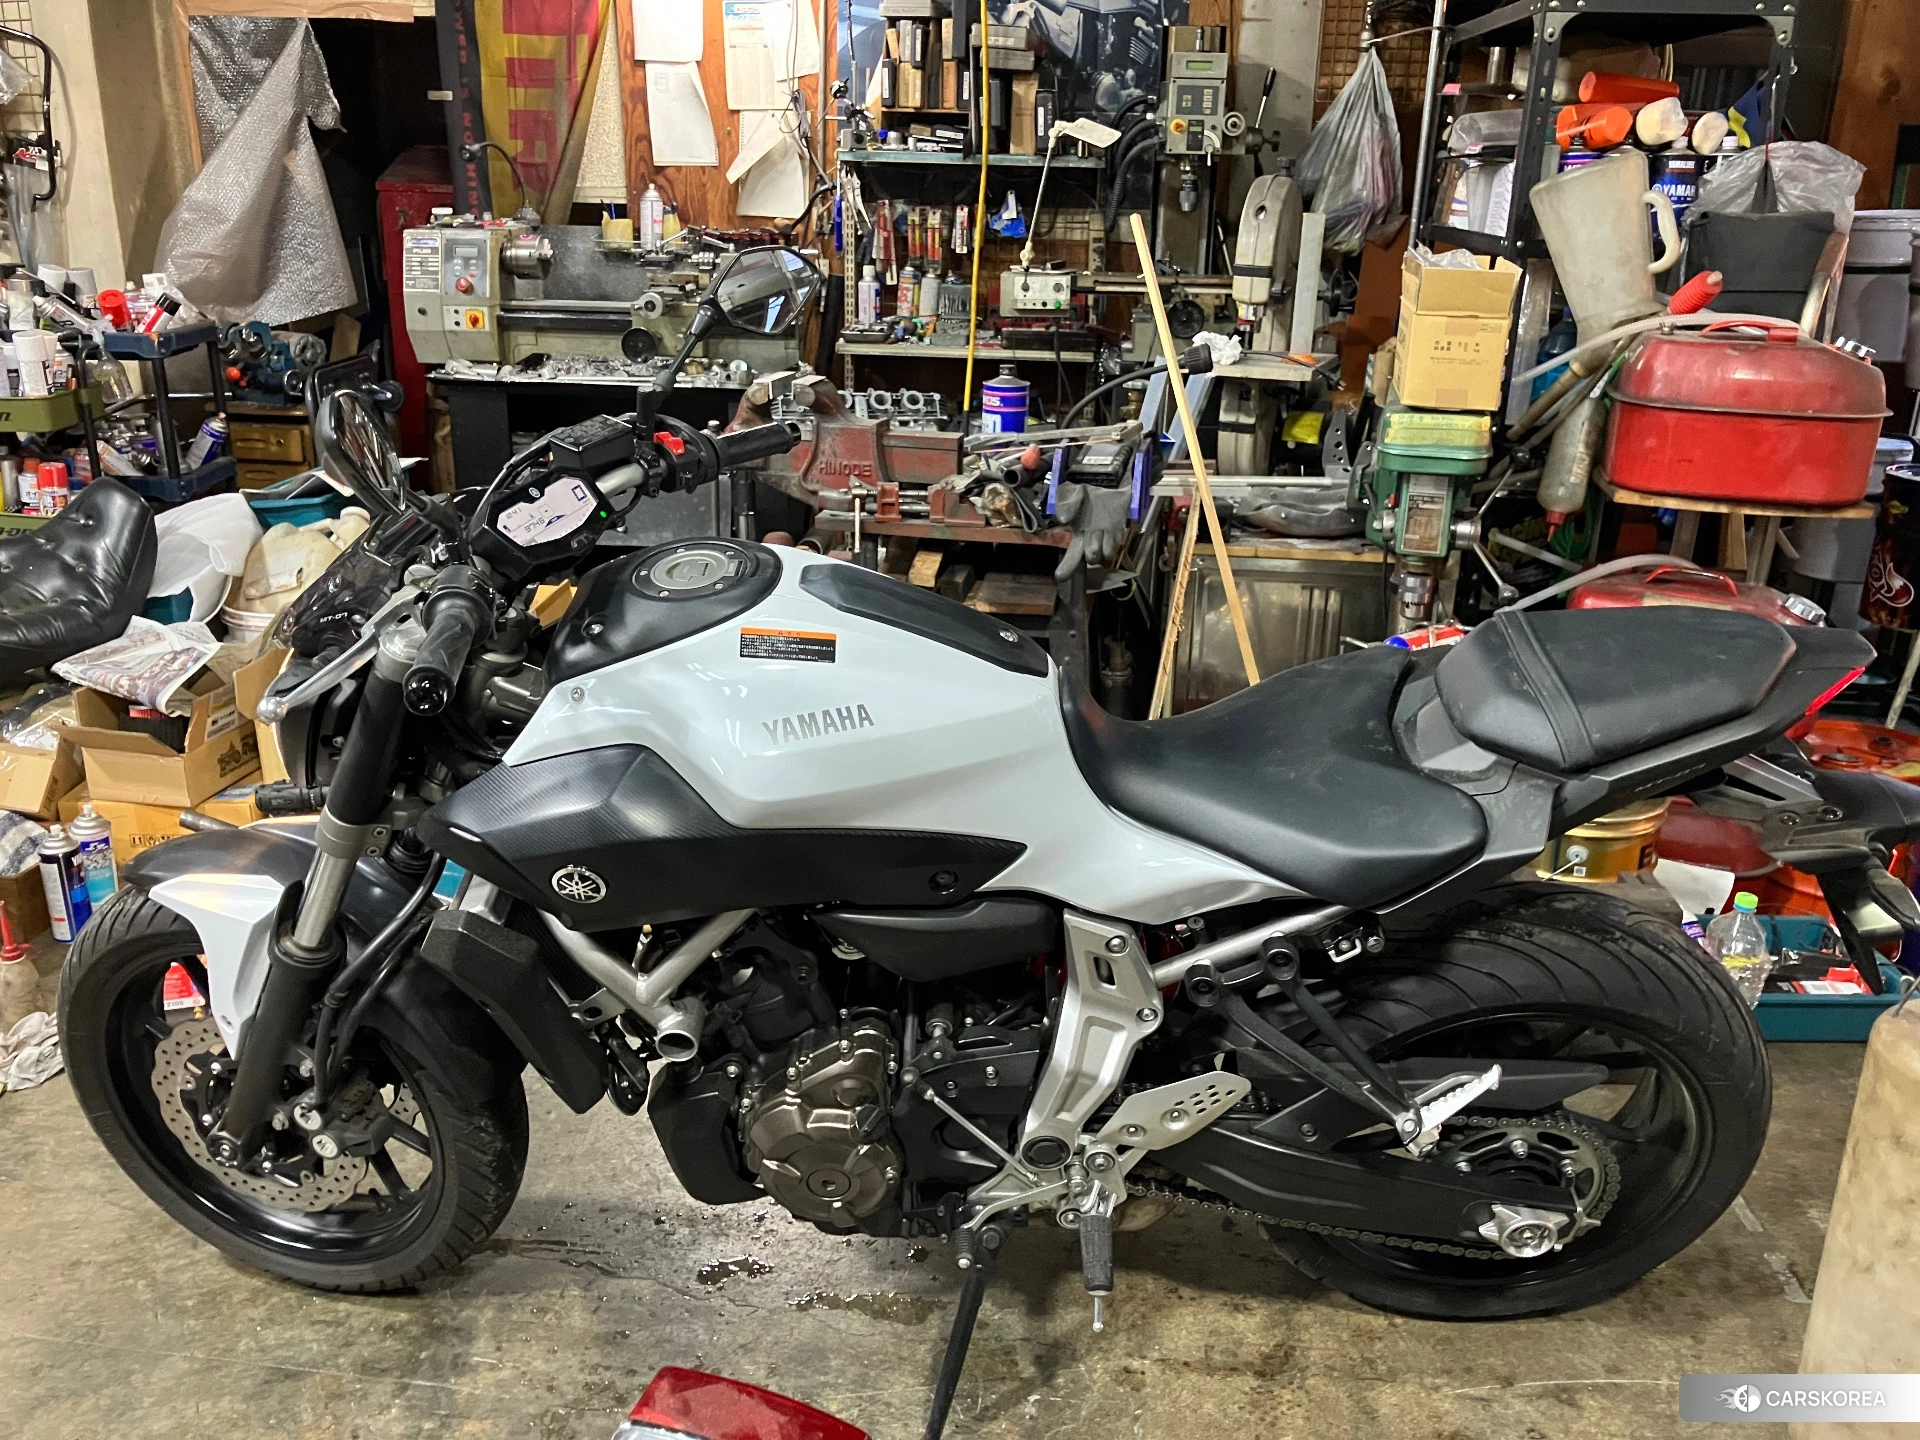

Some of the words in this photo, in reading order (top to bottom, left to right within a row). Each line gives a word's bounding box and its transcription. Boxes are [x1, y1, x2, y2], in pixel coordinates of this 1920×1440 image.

[819, 460, 872, 477] HINODE
[320, 611, 348, 623] MT-07
[761, 703, 875, 745] YAMAHA
